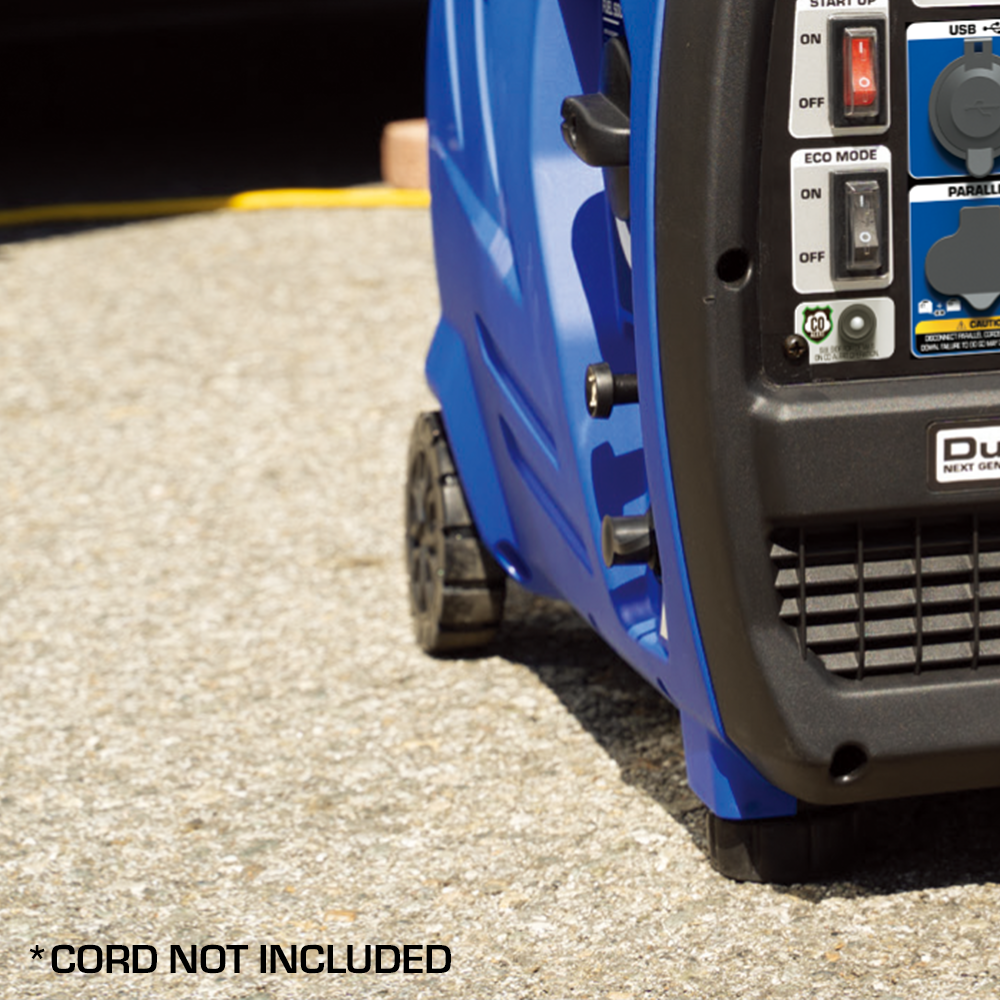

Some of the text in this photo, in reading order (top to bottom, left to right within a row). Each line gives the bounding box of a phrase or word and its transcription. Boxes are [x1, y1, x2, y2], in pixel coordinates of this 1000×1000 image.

[949, 24, 977, 36] USB
[800, 33, 822, 45] ON
[799, 97, 825, 109] OFF
[804, 150, 877, 164] ECO MODE
[800, 188, 822, 200] ON
[799, 251, 825, 263] OFF
[810, 316, 825, 332] CO
[943, 463, 974, 473] NEXT
